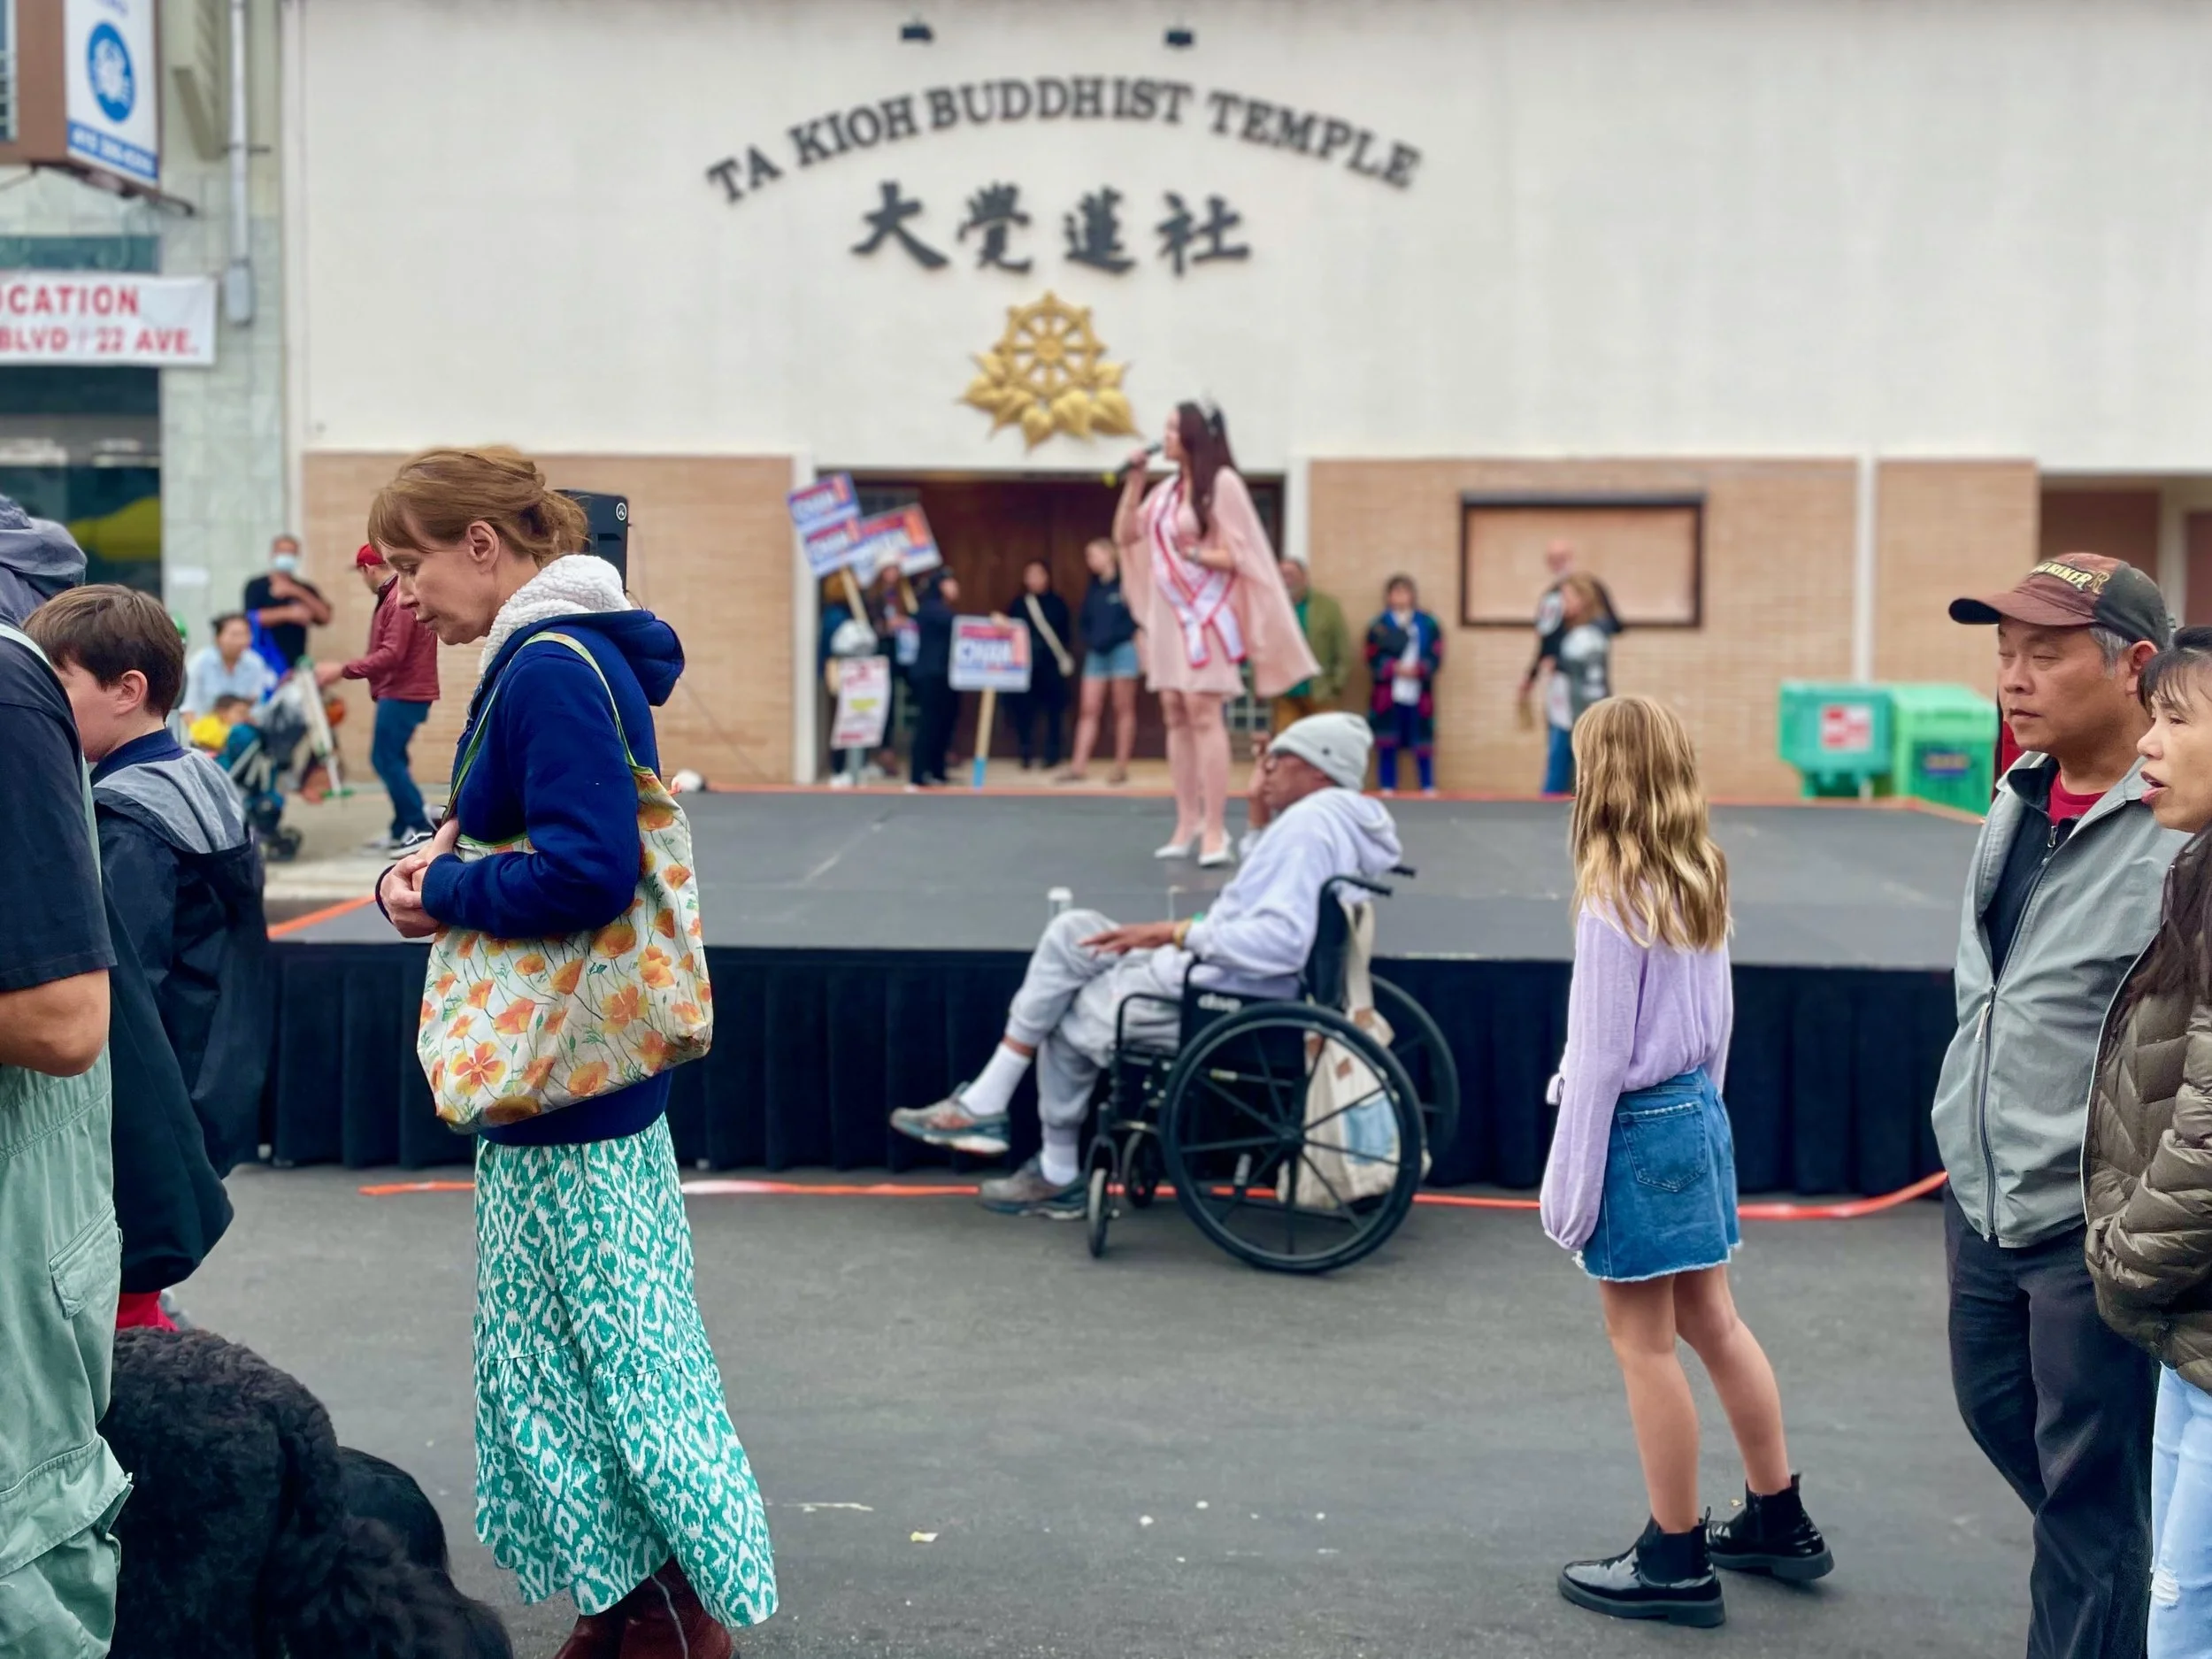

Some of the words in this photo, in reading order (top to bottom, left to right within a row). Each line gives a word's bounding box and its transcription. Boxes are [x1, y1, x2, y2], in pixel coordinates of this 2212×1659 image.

[706, 143, 783, 204] TA
[786, 93, 918, 167] KIOH
[925, 74, 1194, 131] BUDDHIST
[1207, 89, 1422, 190] TEMPLE
[0, 284, 139, 316] CATION
[0, 326, 70, 352] BLVD
